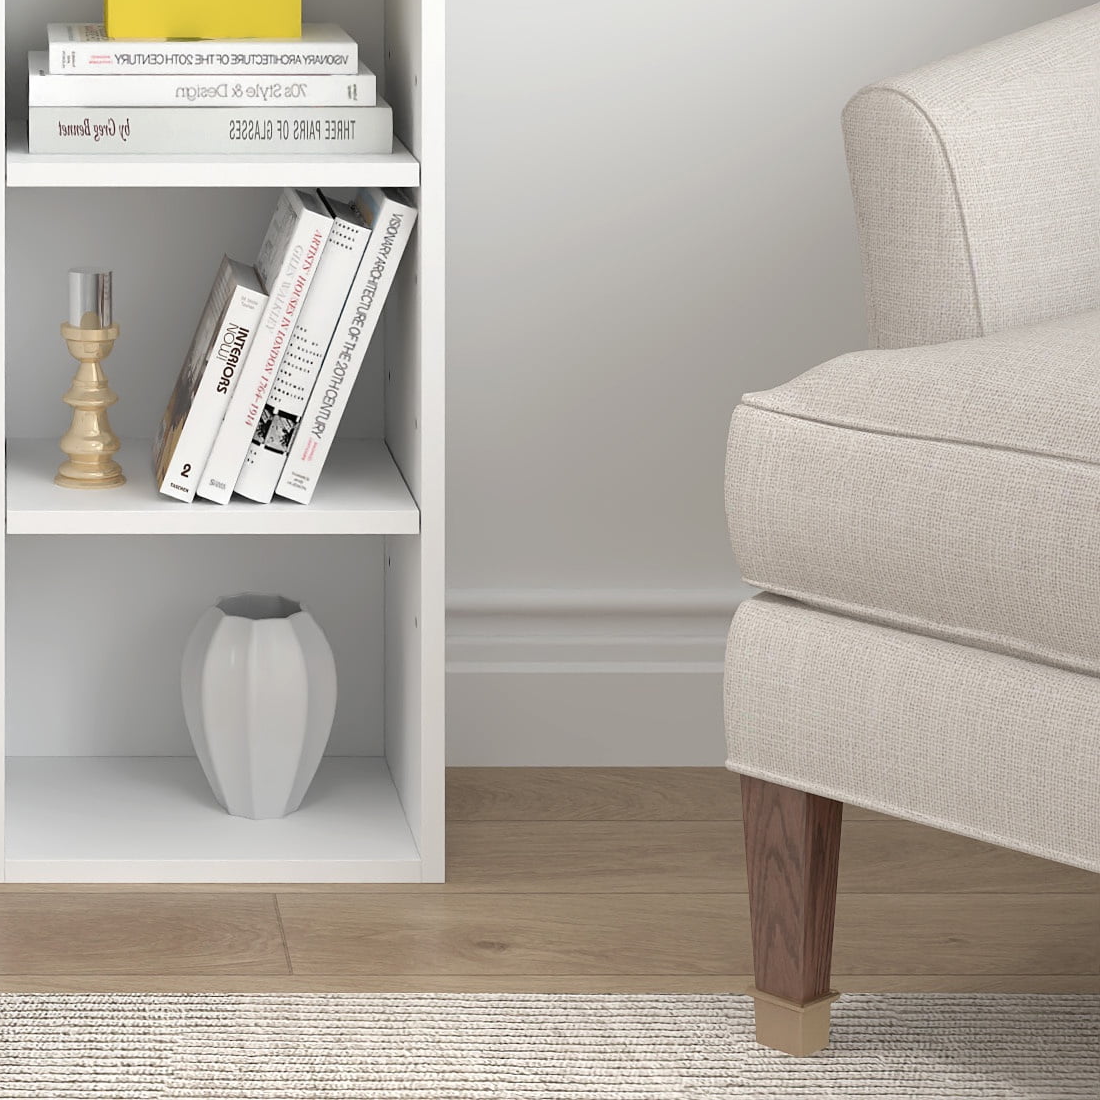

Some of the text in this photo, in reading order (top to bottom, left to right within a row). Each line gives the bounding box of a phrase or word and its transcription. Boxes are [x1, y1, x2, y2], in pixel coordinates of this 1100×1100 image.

[287, 275, 308, 316] HOUSES
[280, 316, 292, 330] IN
[311, 213, 404, 440] VISIONARY ARCHITECTURE OF THE 20TH CENTURY
[216, 327, 250, 395] INTERIORS
[264, 330, 286, 376] LONDON
[170, 482, 189, 493] TASCHEN
[180, 463, 192, 478] 2
